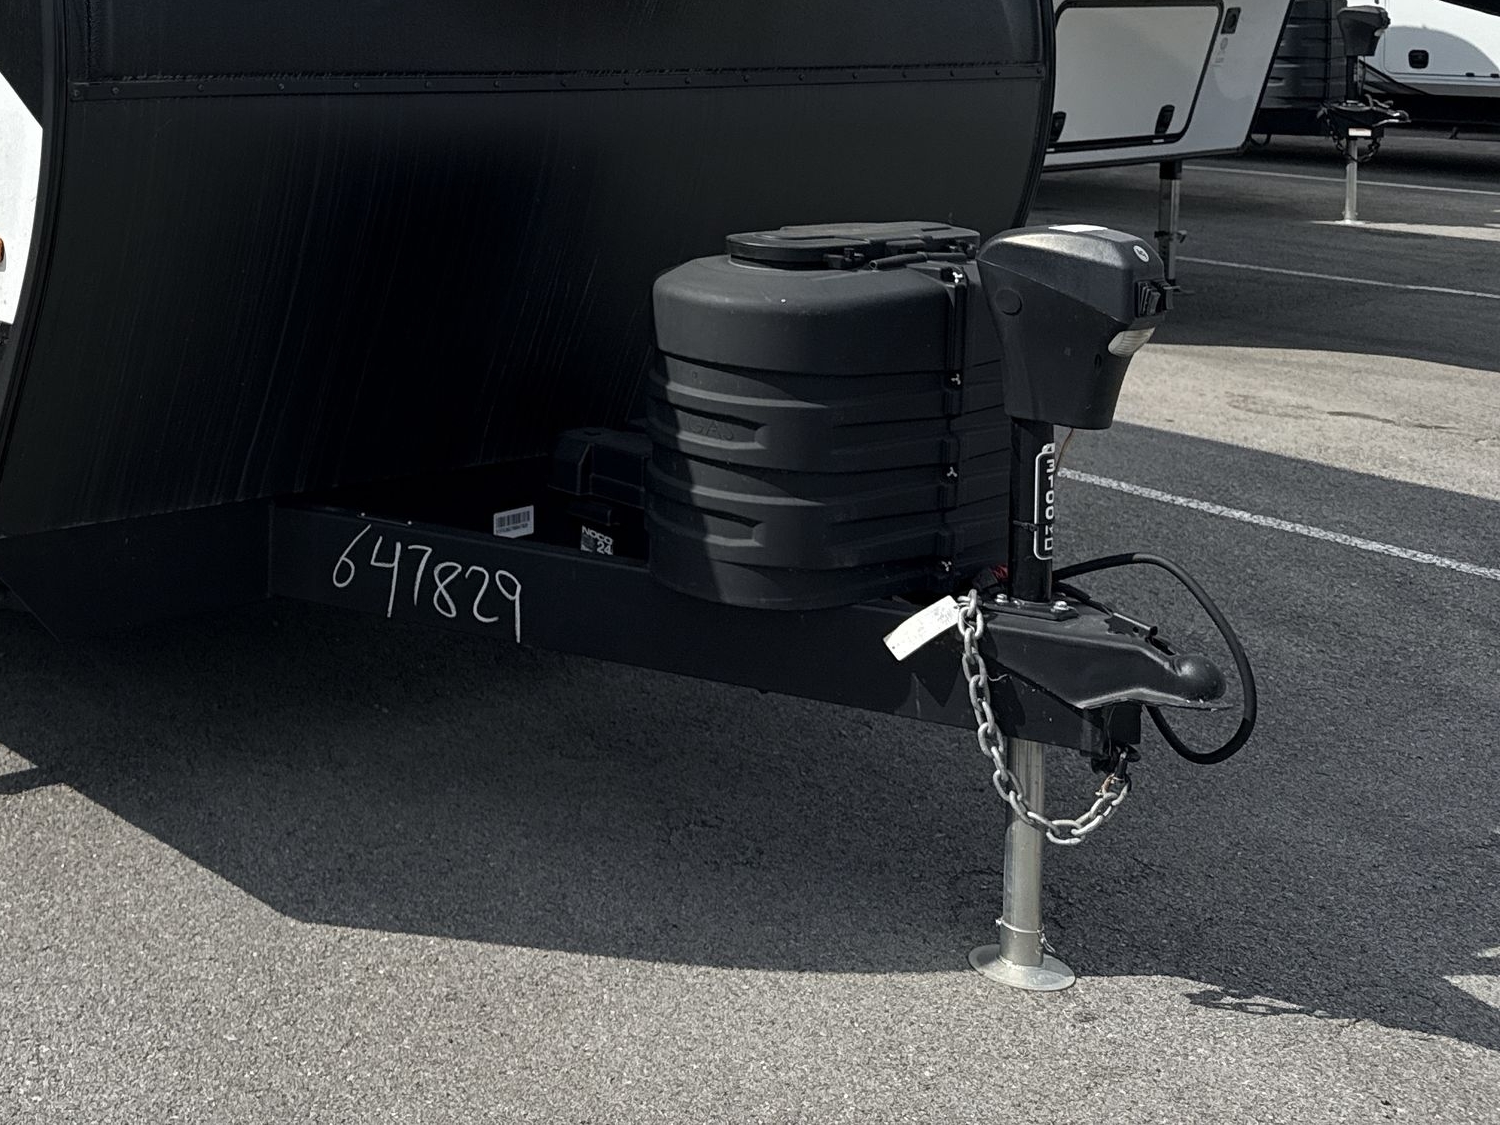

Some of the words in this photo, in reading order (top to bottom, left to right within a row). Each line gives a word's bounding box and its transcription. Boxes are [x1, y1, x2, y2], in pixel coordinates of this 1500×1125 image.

[581, 525, 614, 546] NOCO
[596, 541, 613, 555] 24
[332, 524, 522, 643] 647829
